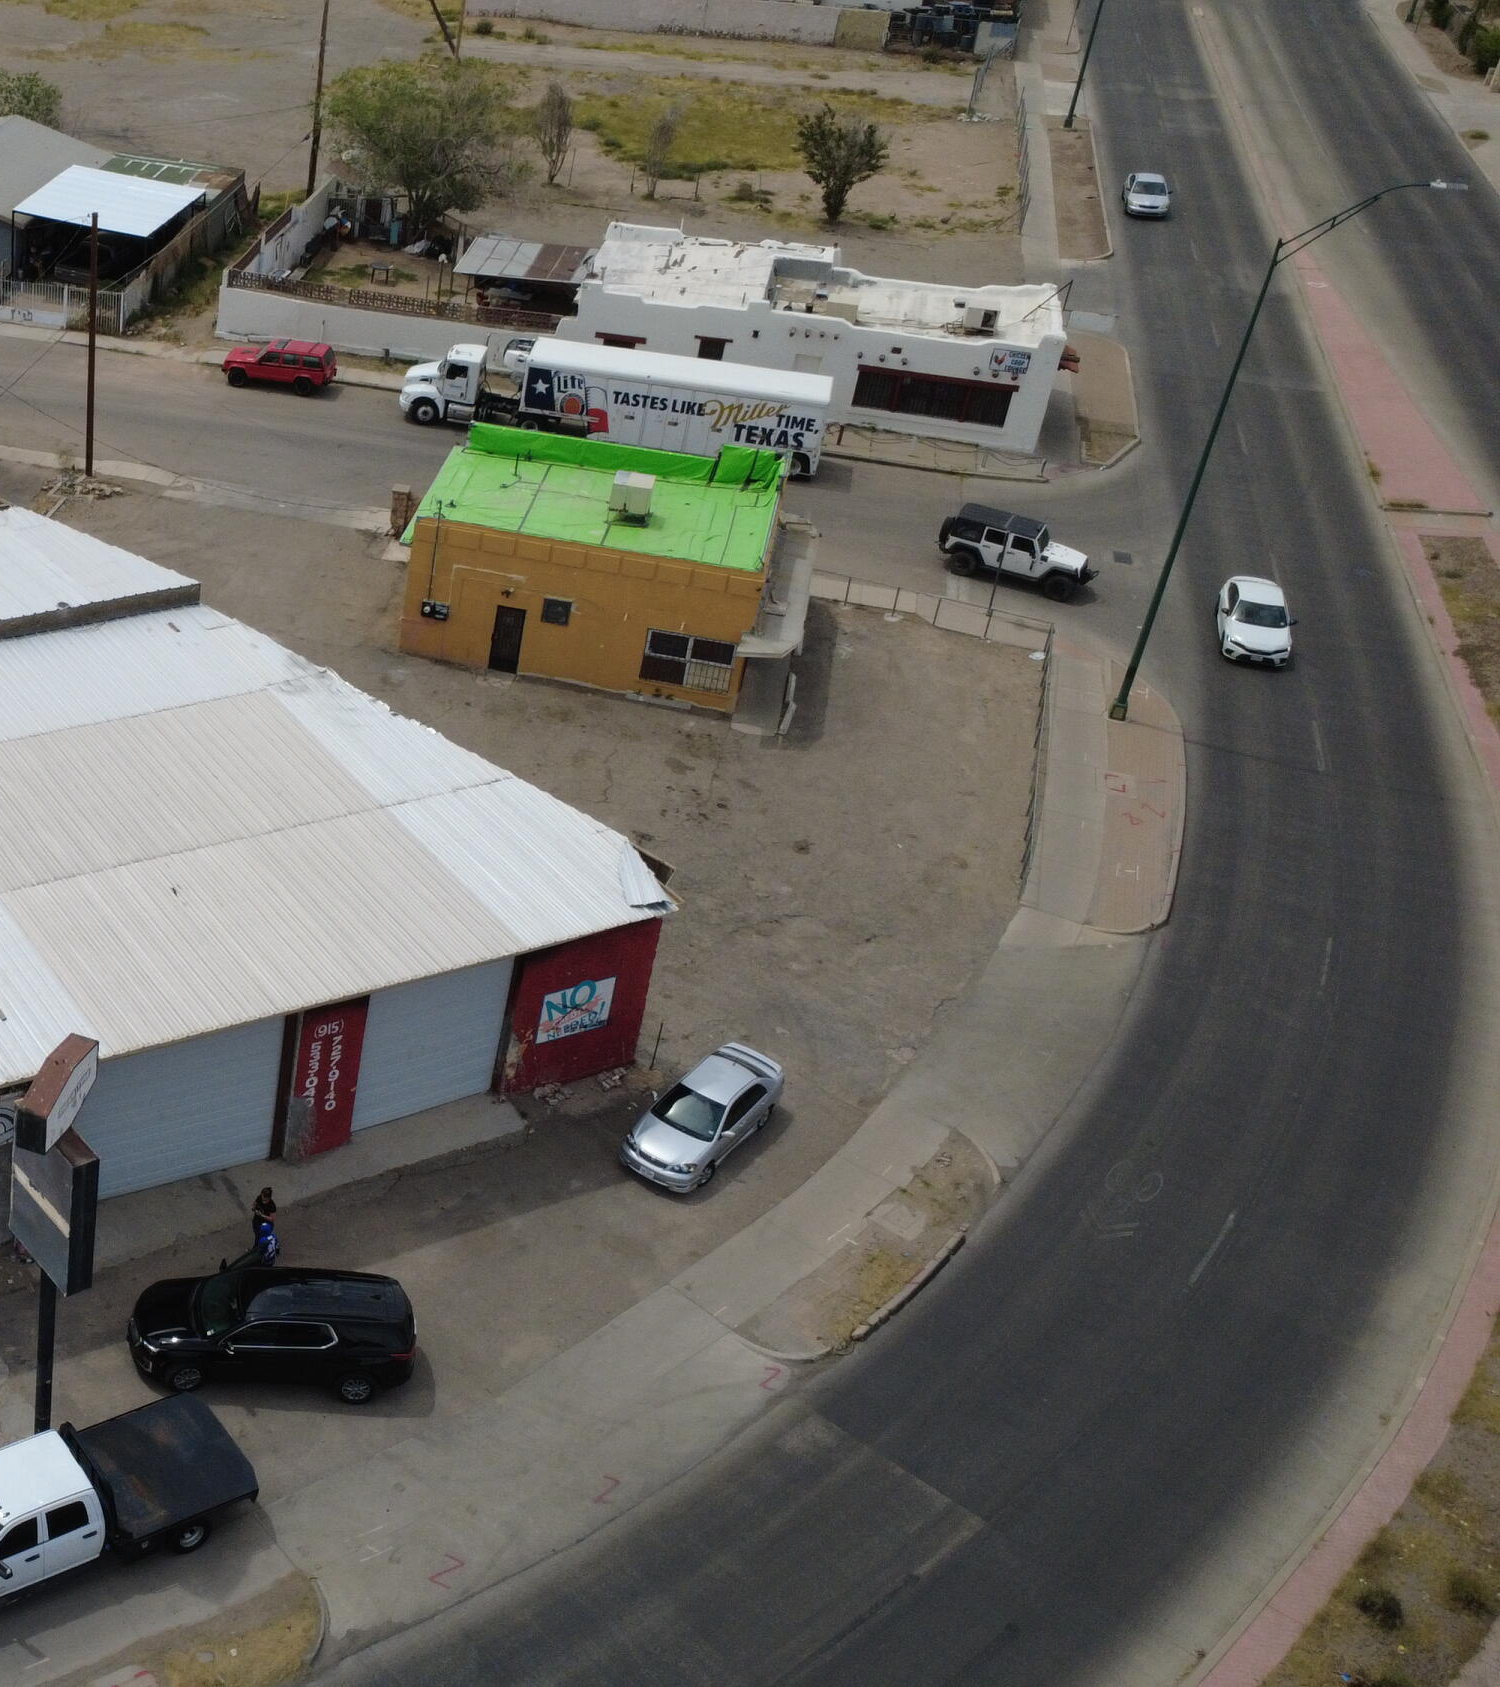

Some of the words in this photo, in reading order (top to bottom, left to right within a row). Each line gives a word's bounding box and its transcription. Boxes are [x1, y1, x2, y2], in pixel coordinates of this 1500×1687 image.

[556, 374, 584, 394] Lite
[613, 391, 668, 411] TASTES
[671, 399, 707, 417] LIKE
[704, 399, 790, 433] Miller
[776, 414, 819, 434] TIME,
[733, 423, 804, 449] TEXAS
[546, 980, 597, 1022] NO
[314, 1019, 345, 1039] (915)
